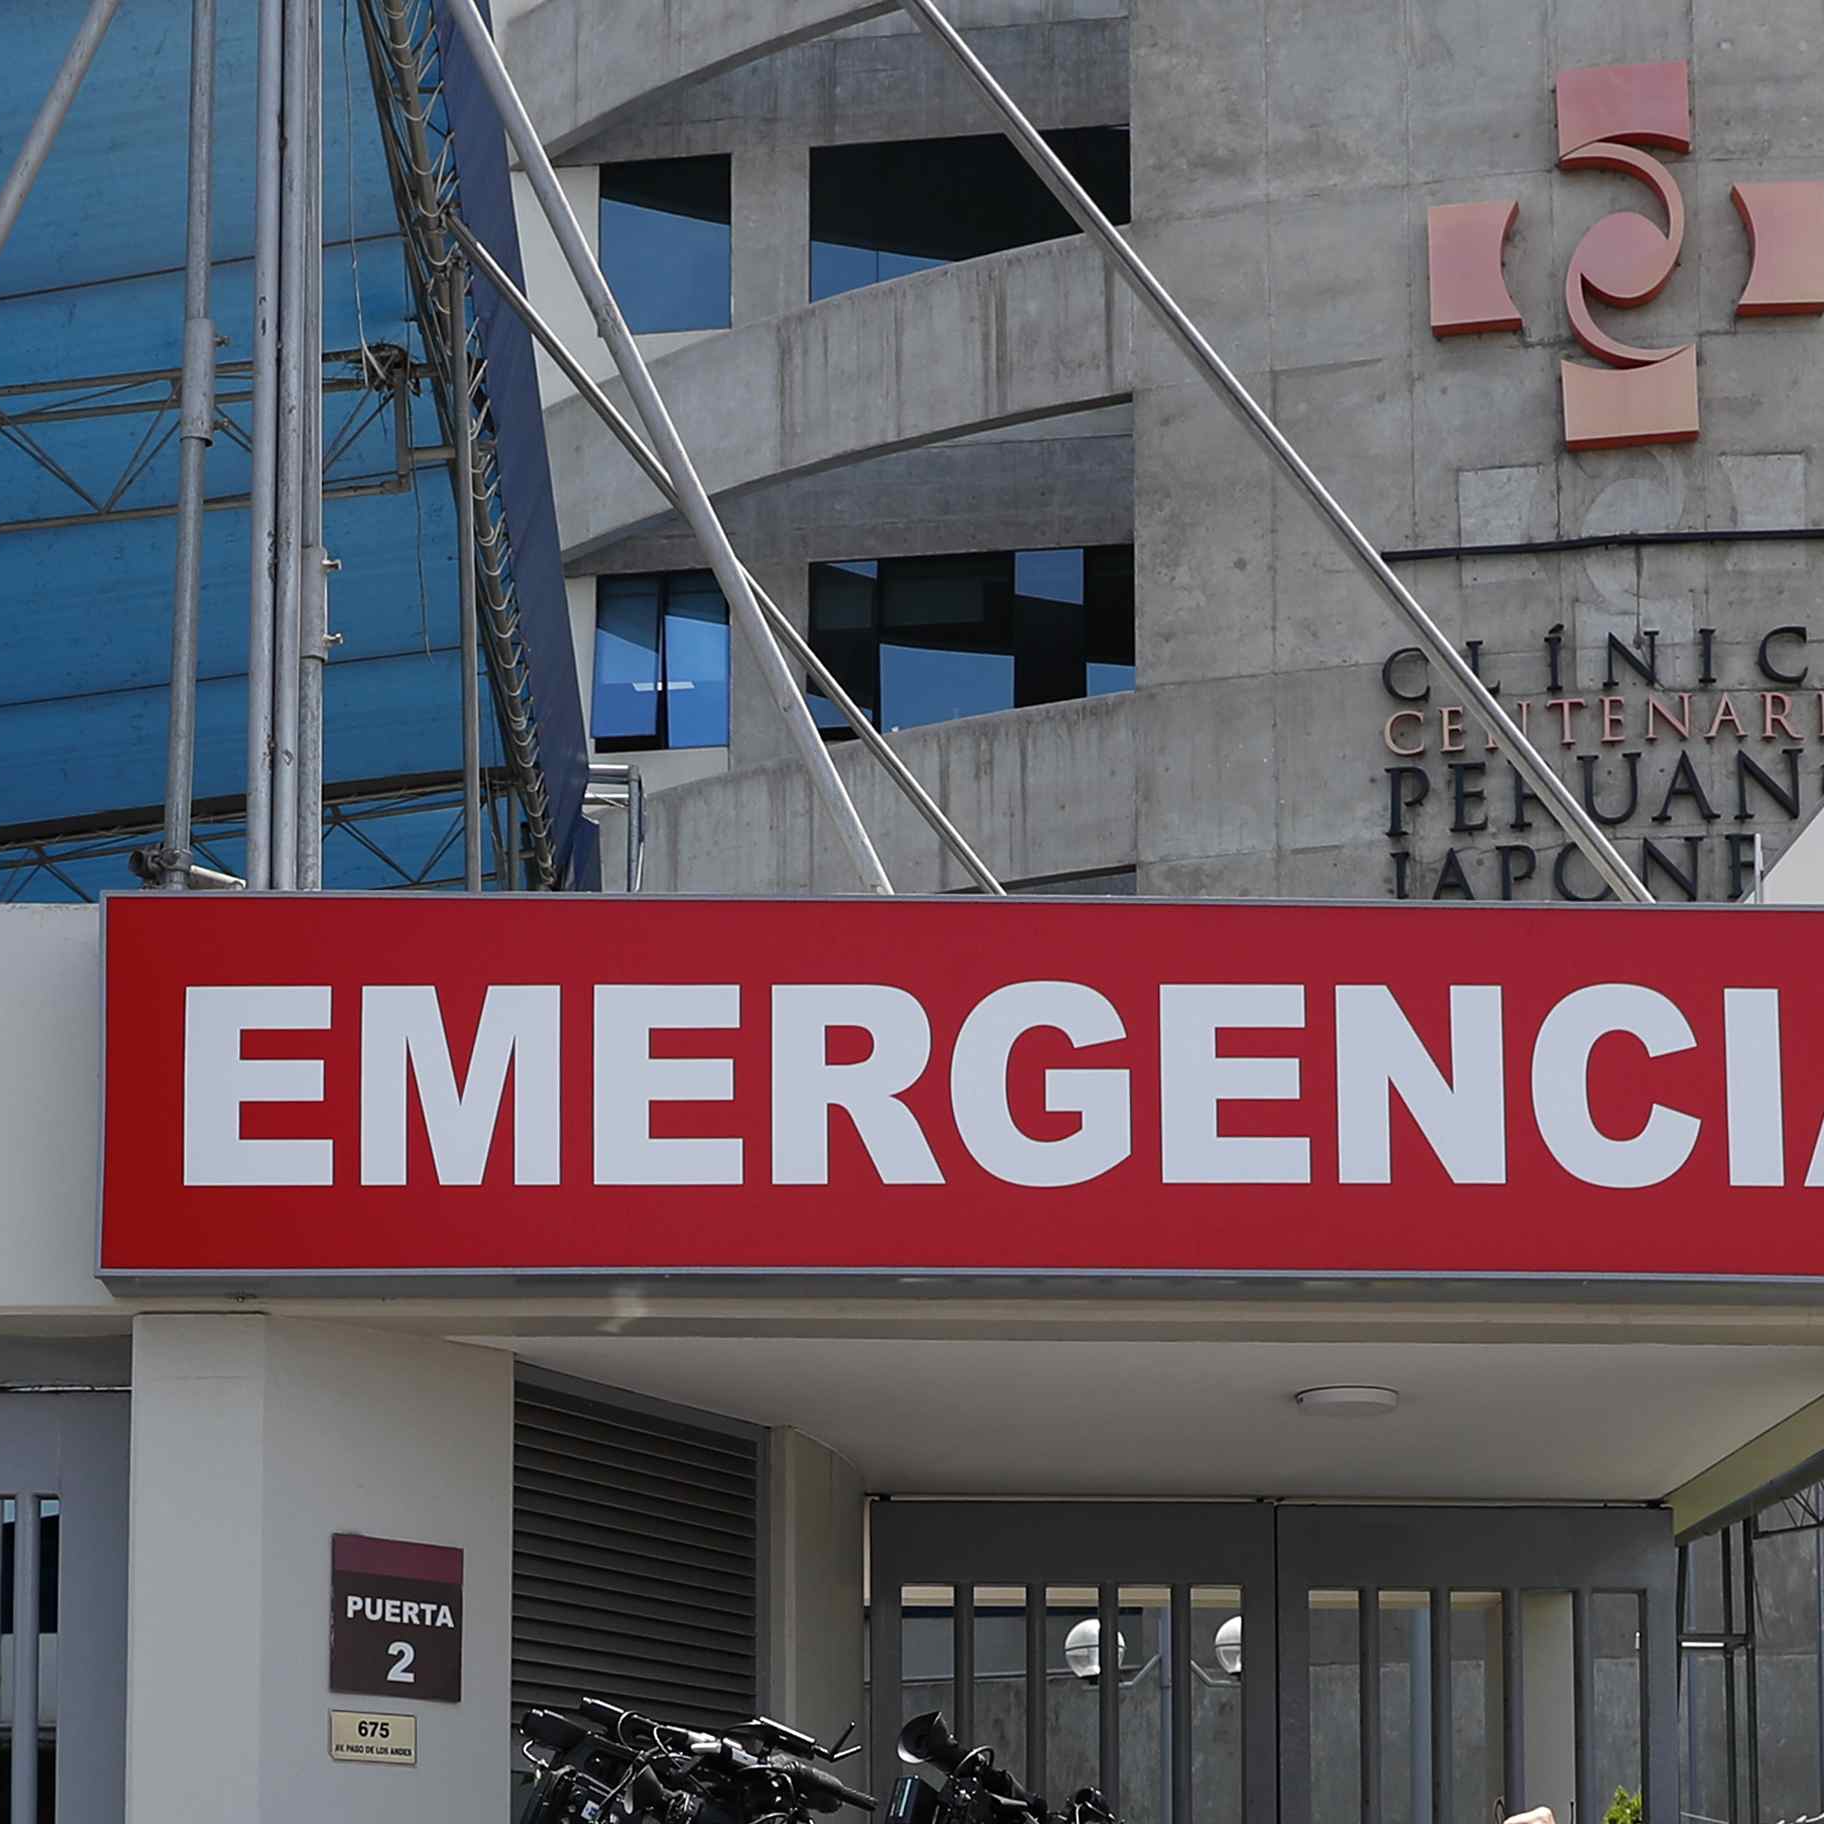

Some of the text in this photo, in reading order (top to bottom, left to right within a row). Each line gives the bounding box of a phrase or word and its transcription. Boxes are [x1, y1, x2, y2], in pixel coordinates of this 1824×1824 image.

[346, 1595, 455, 1628] PUERTA
[387, 1641, 415, 1683] 2
[358, 1720, 390, 1738] 675
[365, 1745, 374, 1754] DE
